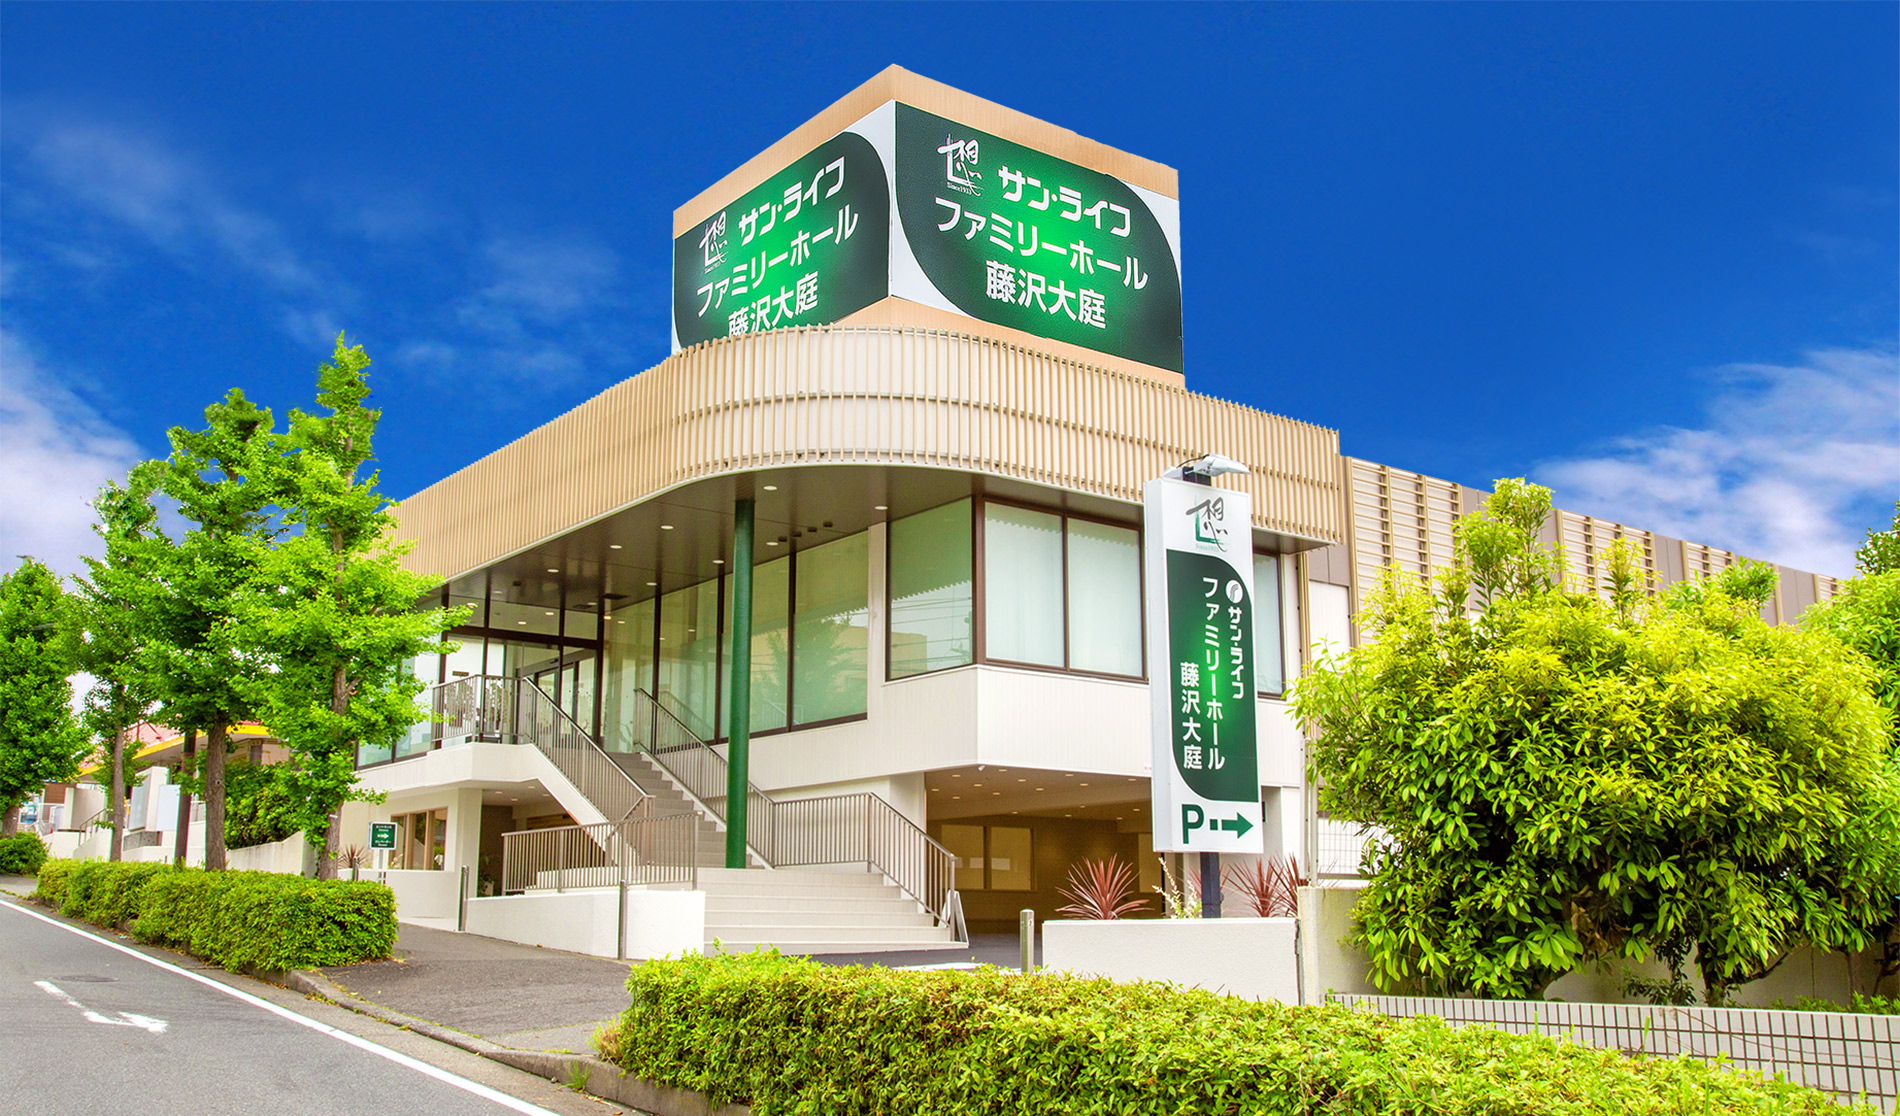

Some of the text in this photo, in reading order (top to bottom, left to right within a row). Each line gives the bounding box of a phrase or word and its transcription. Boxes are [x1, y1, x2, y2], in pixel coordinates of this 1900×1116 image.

[739, 156, 845, 246] サン・ライフ
[935, 196, 1148, 290] ファミリーホール
[998, 165, 1131, 238] サン・ライフ
[697, 204, 858, 318] ファミリーホール
[728, 271, 818, 338] 藤沢大庭
[986, 260, 1106, 329] 藤沢大庭
[1203, 577, 1225, 770] ファミリーホール
[1228, 606, 1244, 699] サン・ライフ
[1180, 661, 1203, 770] 藤沢大庭
[1181, 803, 1204, 844] P
